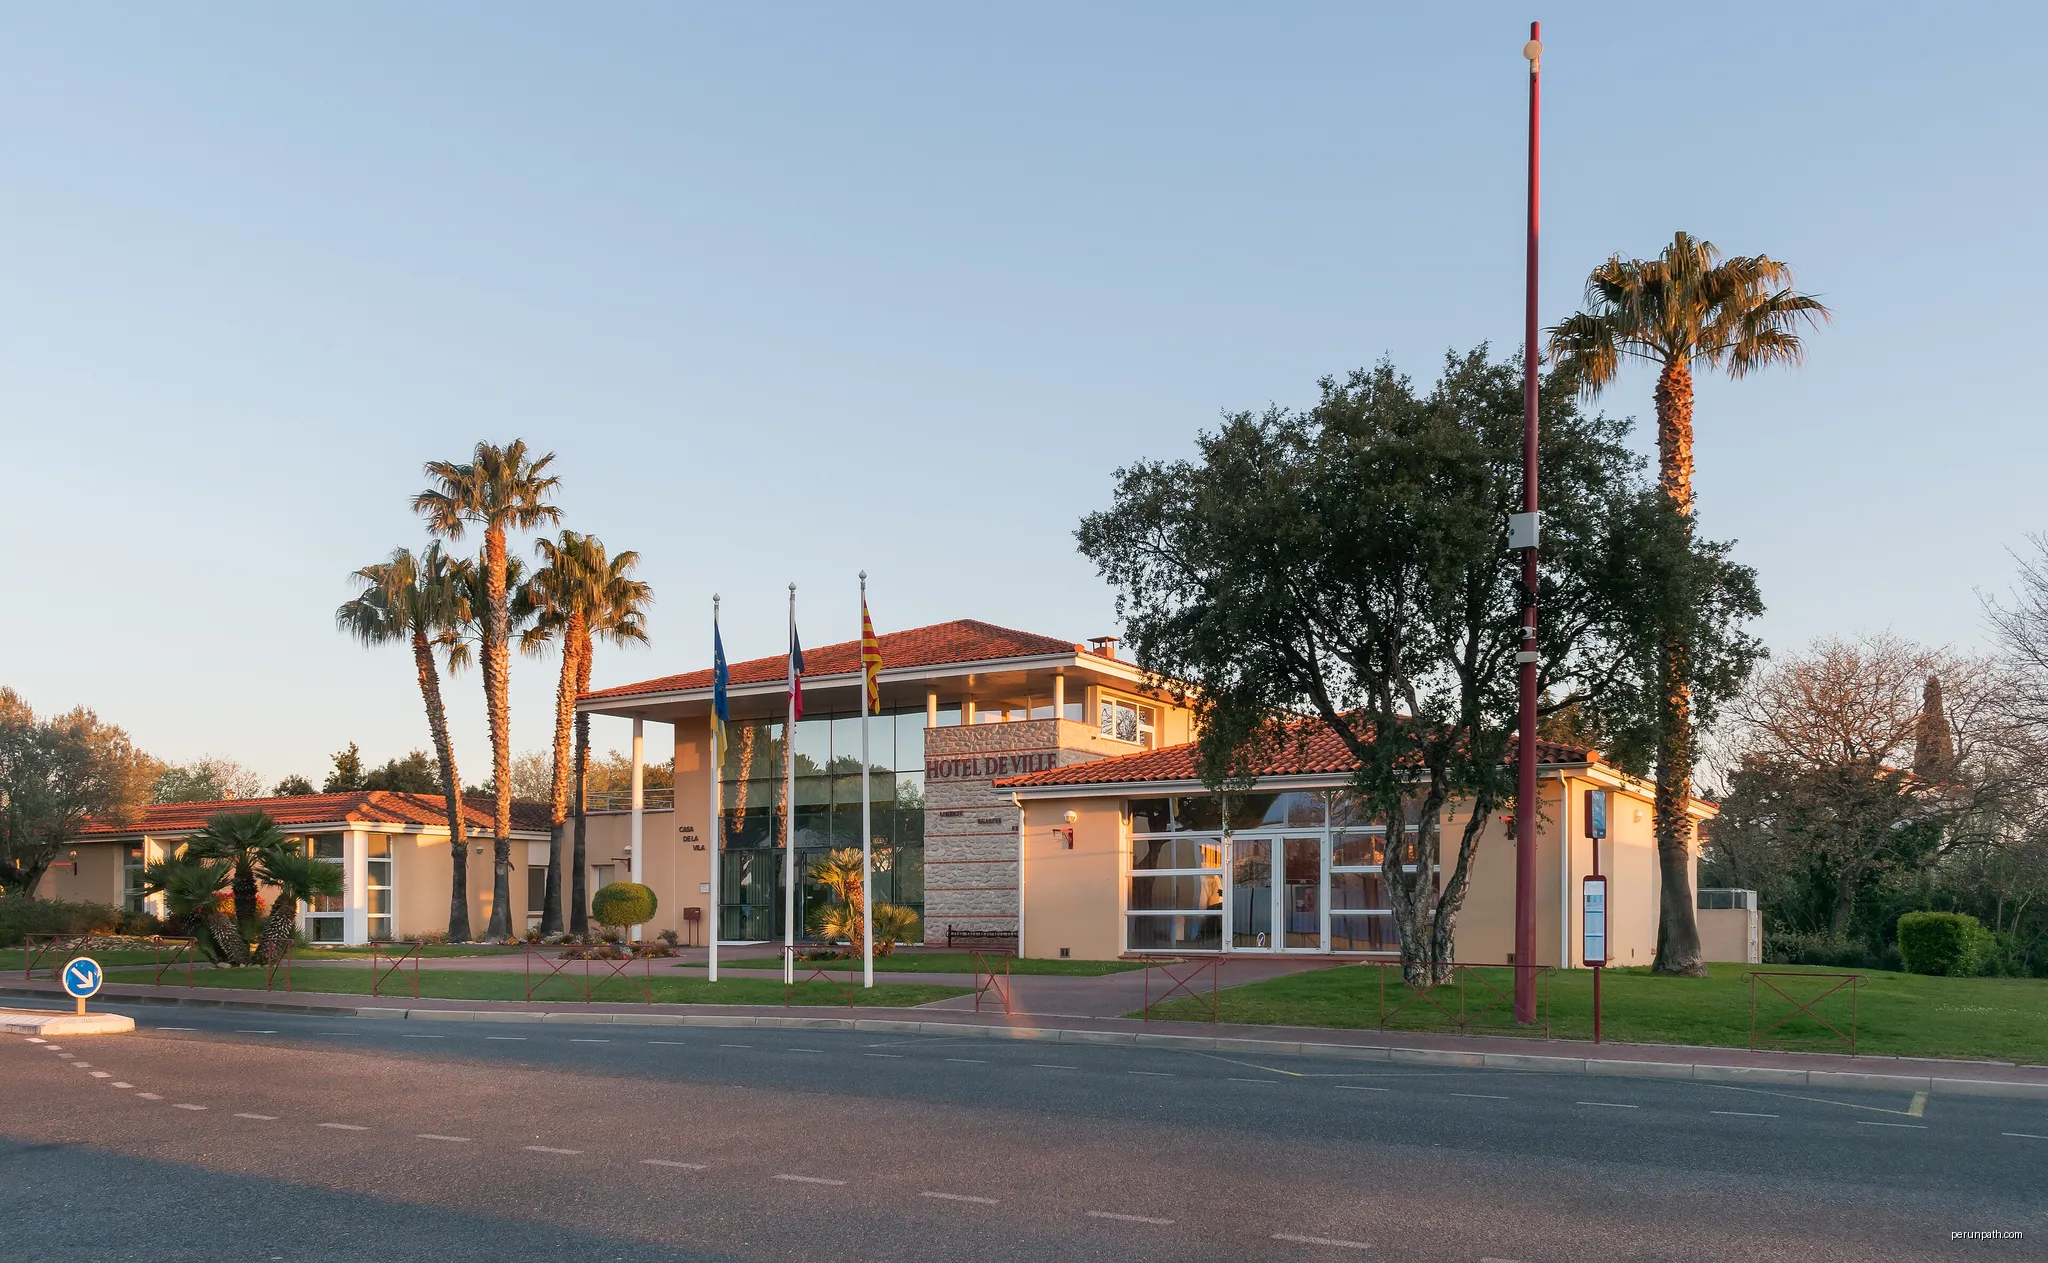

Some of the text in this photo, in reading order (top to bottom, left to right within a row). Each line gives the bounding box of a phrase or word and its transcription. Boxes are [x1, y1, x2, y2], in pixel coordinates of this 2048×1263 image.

[926, 753, 1057, 779] HOTEL DE VILLE
